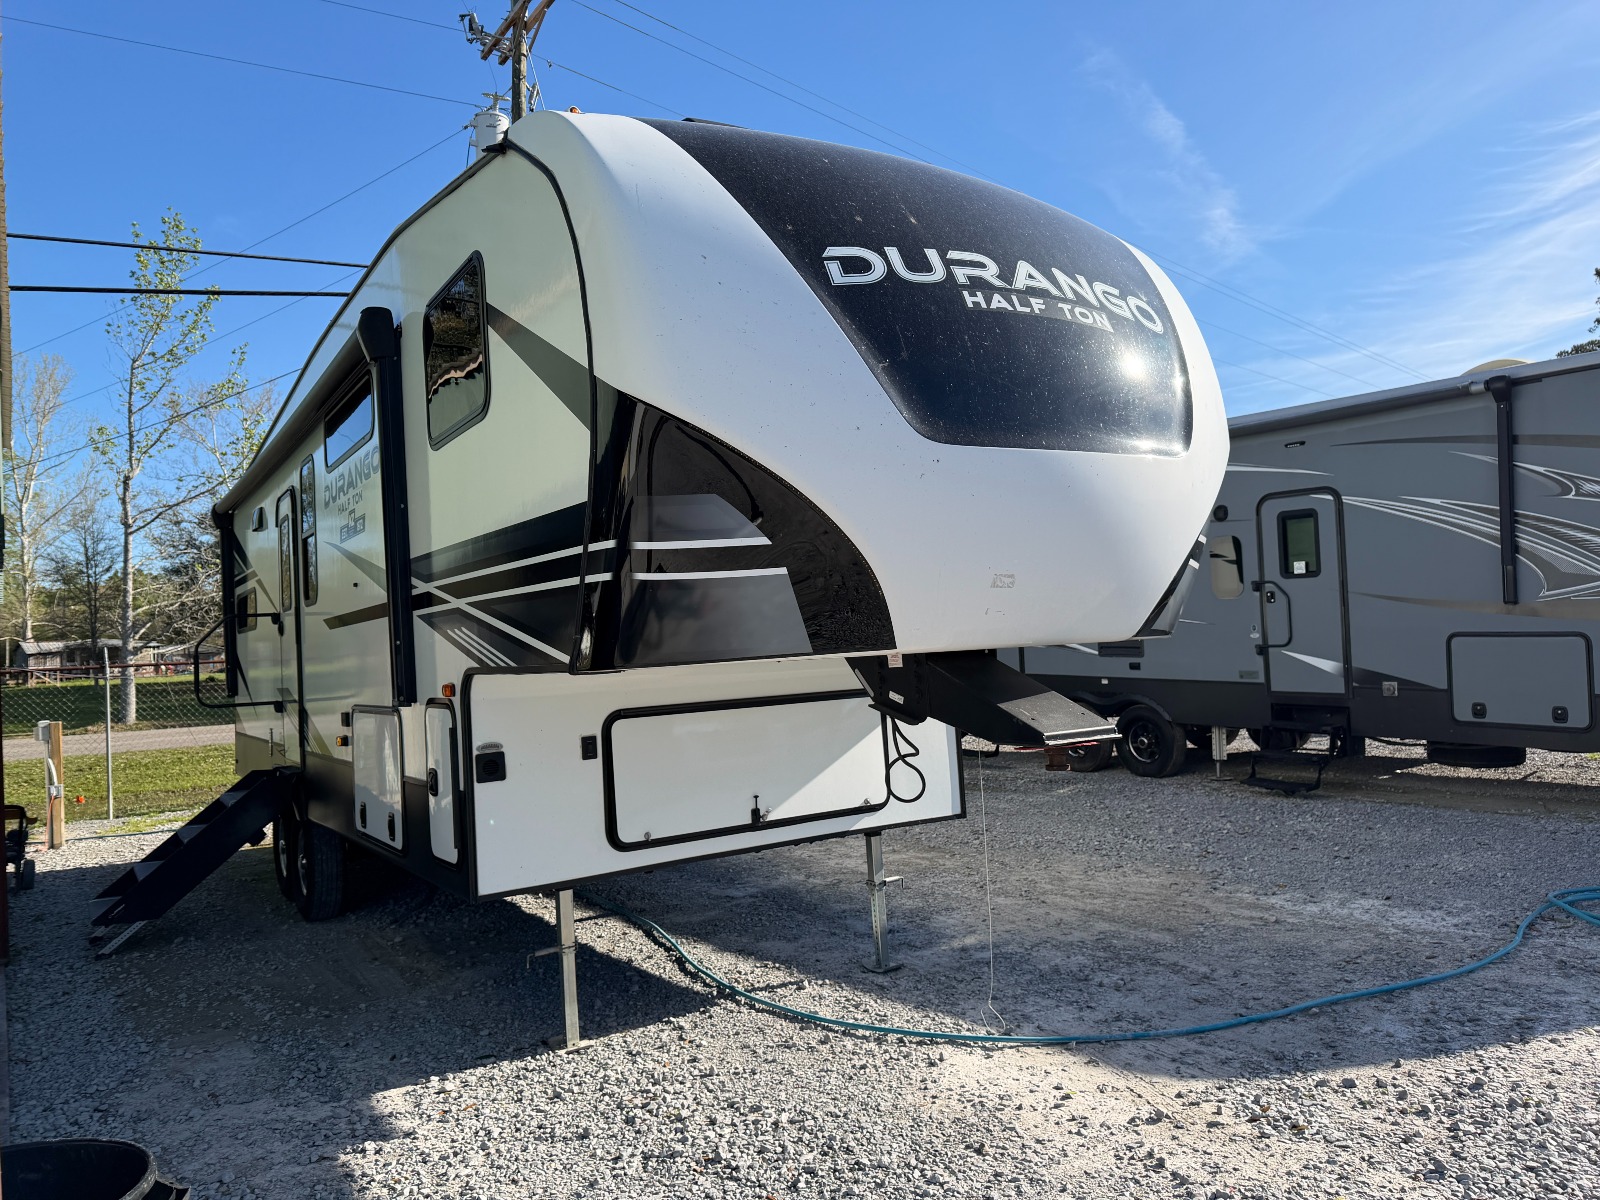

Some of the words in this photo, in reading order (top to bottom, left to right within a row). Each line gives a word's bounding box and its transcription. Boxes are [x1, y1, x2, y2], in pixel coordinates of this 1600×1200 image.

[822, 246, 1164, 334] DURANGO
[962, 290, 1046, 314] HALF
[1058, 302, 1114, 333] TON
[324, 446, 380, 510] DURANGO
[337, 497, 351, 516] HALF
[352, 489, 363, 507] TON
